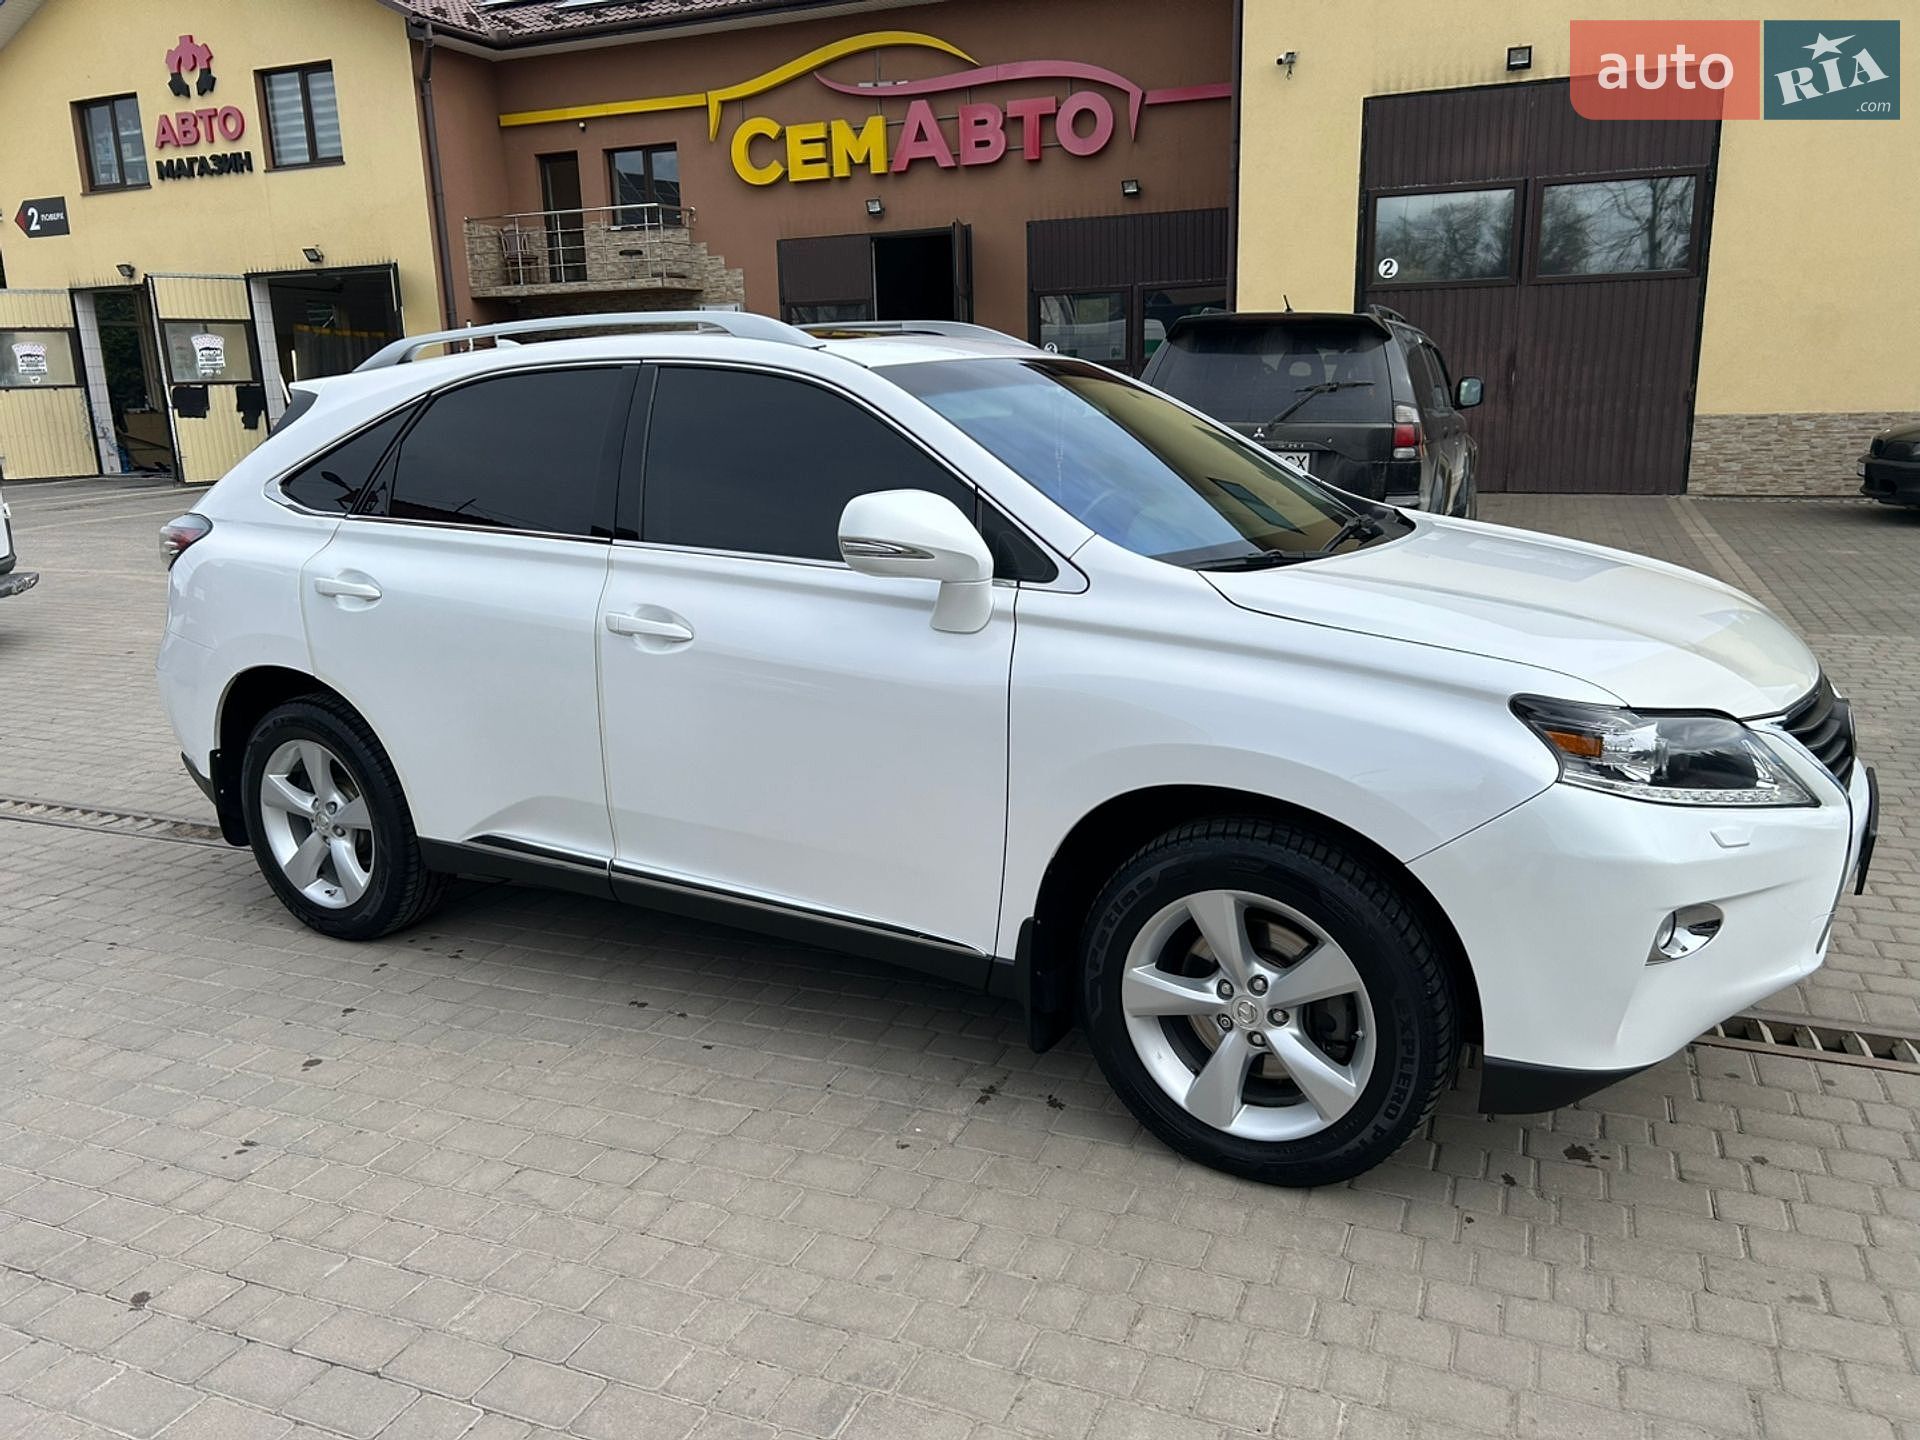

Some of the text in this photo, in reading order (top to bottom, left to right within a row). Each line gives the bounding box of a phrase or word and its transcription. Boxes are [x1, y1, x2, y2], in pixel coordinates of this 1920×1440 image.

[155, 105, 245, 149] АВТО
[155, 151, 253, 180] МАГАЗИН
[27, 207, 41, 231] 2
[1383, 260, 1393, 276] 2
